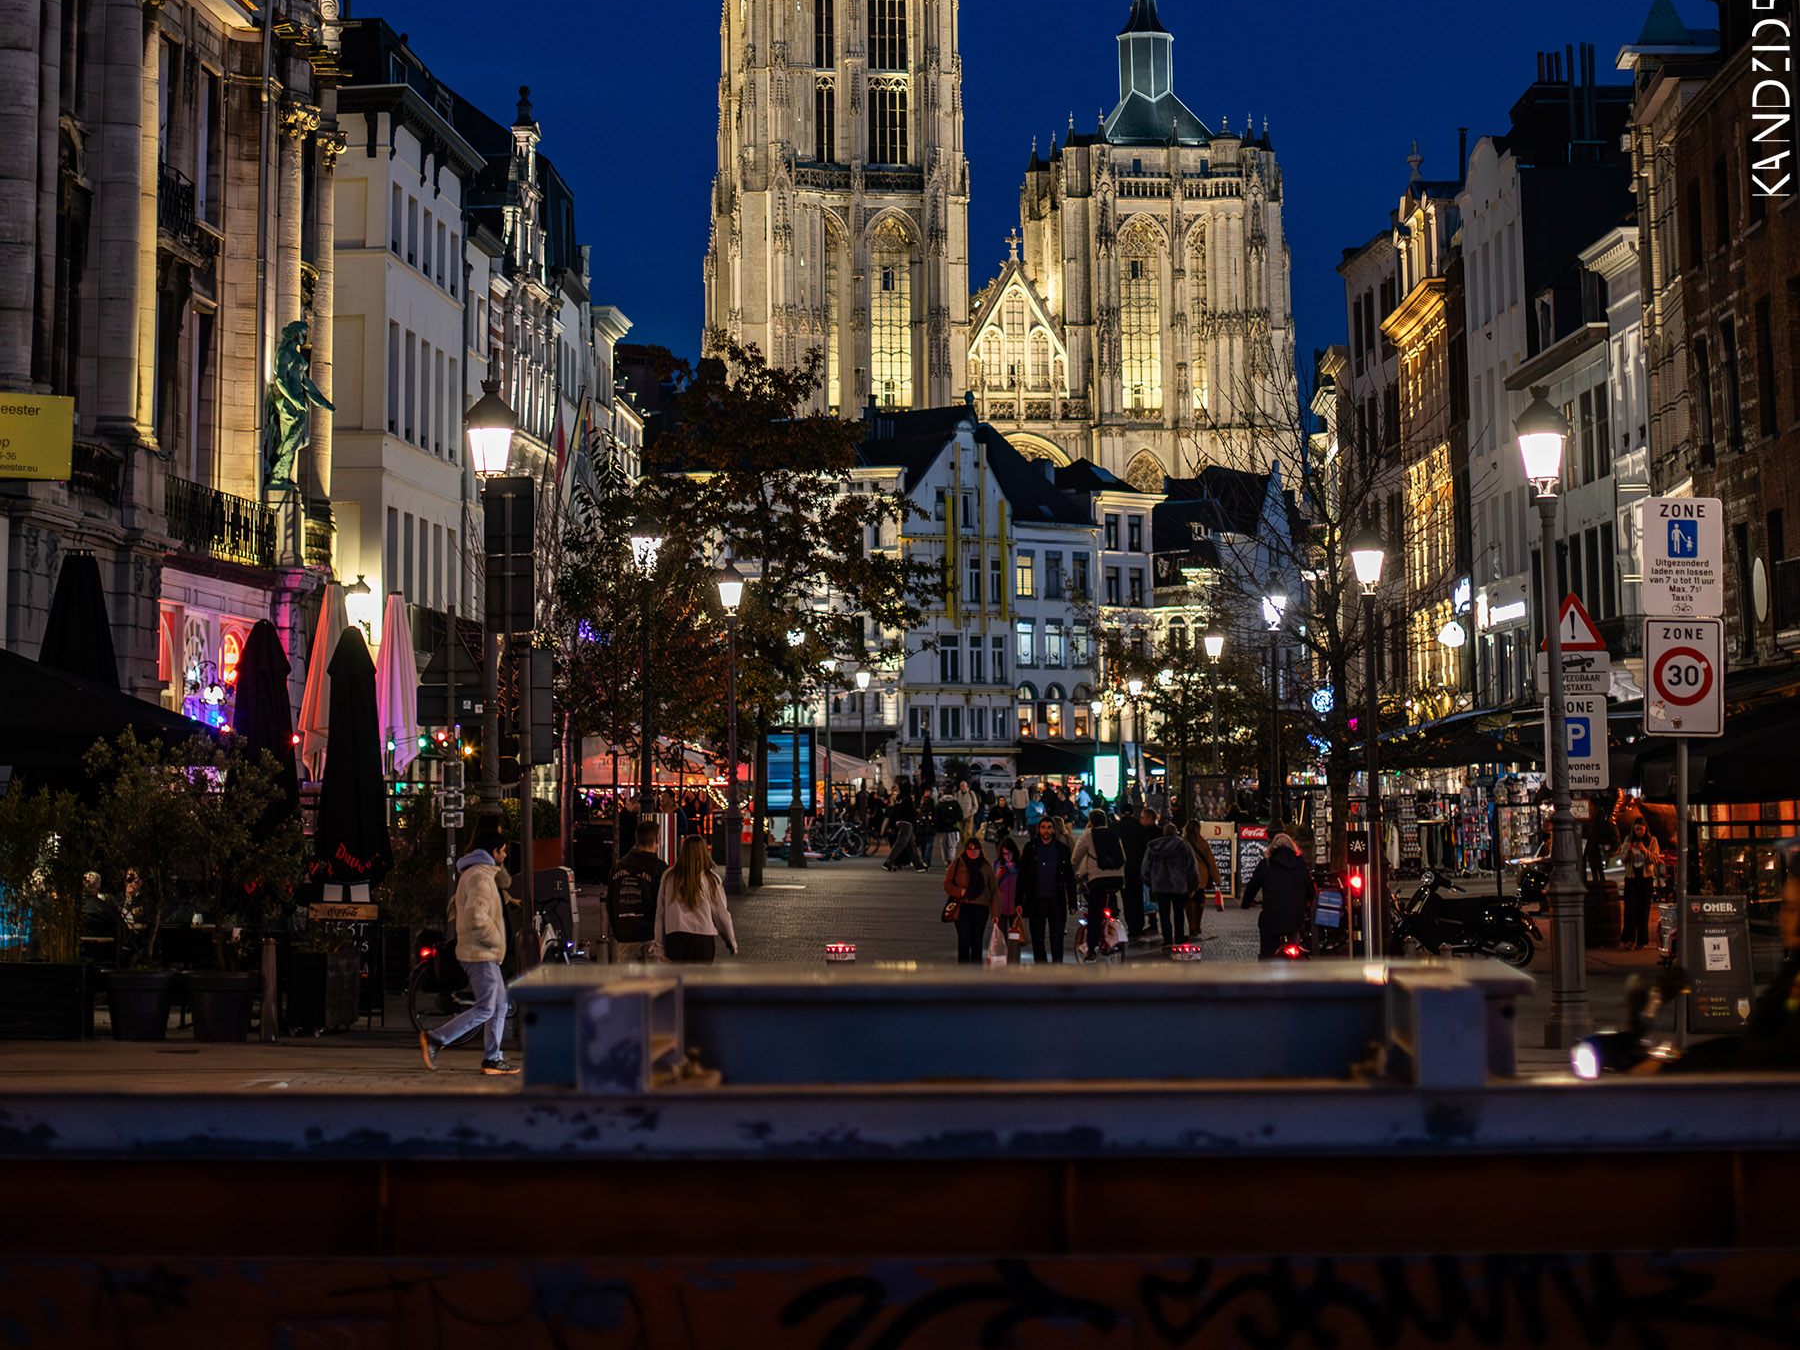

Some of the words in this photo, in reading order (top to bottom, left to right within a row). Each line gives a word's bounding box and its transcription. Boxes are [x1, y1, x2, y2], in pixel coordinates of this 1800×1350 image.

[0, 404, 41, 416] eester
[1660, 504, 1706, 518] ZONE
[1655, 558, 1710, 568] Uitgezonderd
[1651, 567, 1674, 576] laden
[1686, 568, 1714, 576] lossen
[1669, 585, 1689, 593] Max.
[1671, 594, 1694, 602] Taxi's
[1663, 628, 1704, 640] ZONE
[1667, 665, 1699, 686] 30
[1566, 701, 1594, 713] ONE
[1566, 723, 1586, 752] P
